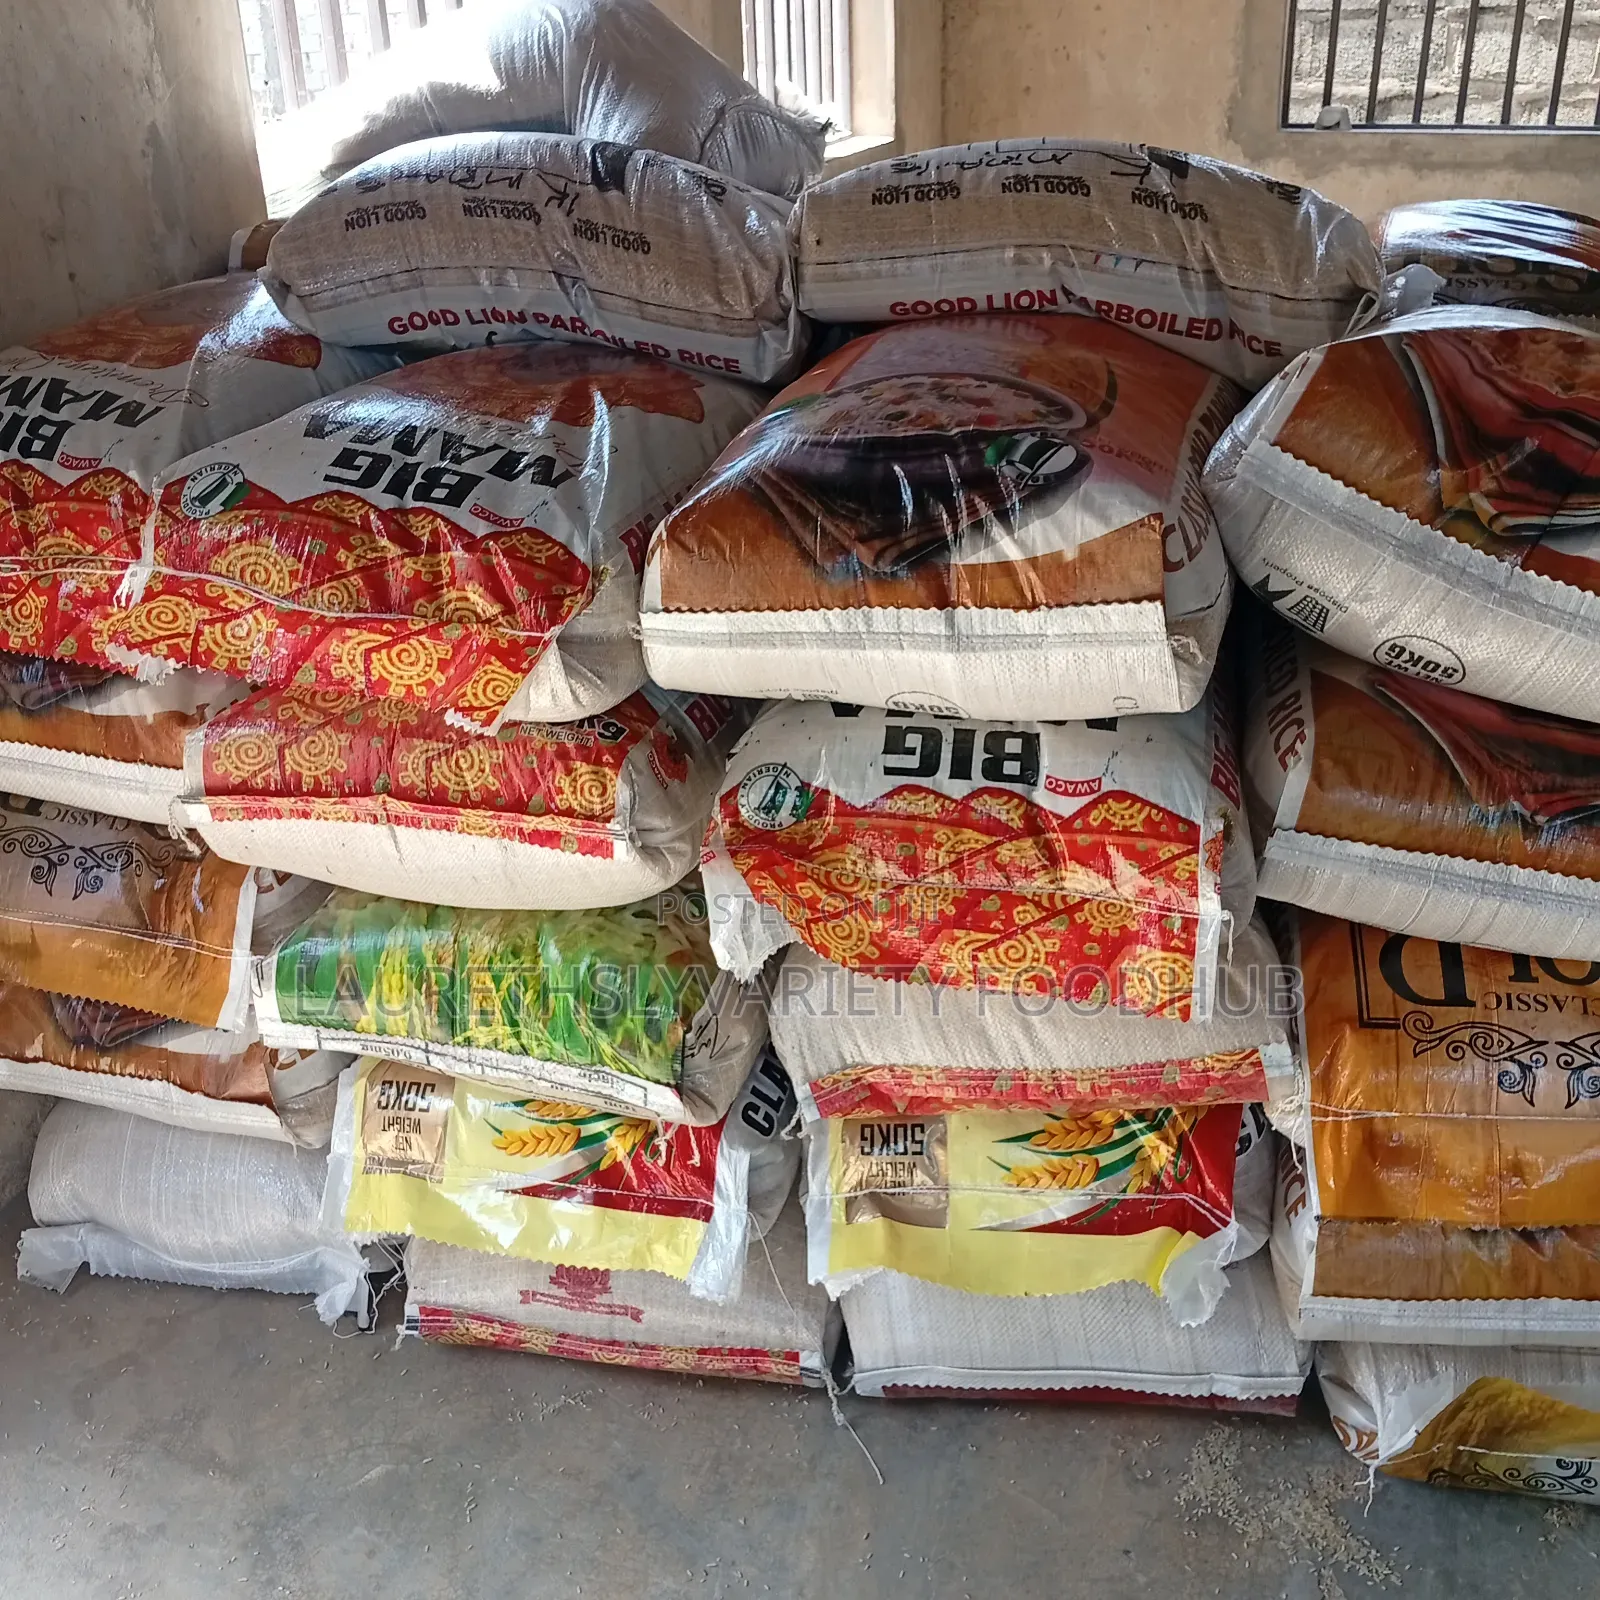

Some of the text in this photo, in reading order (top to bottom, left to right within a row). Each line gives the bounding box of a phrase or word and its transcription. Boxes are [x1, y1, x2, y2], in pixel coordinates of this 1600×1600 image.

[871, 186, 961, 206] GOOD LION
[1001, 180, 1091, 197] GOOD LION
[344, 206, 427, 232] GOOD LION
[462, 203, 542, 226] GOOD LION
[573, 223, 651, 254] GOOD LION
[889, 296, 978, 316] GOOD
[986, 288, 1058, 312] LION
[389, 306, 742, 374] GOOD LION PAROILED RICE
[0, 411, 76, 461] BI
[58, 453, 102, 469] AWACO
[190, 464, 240, 483] NGERIAN
[323, 447, 486, 508] BIG
[470, 504, 522, 527] AWACO
[1385, 642, 1459, 679] 50KG
[519, 724, 544, 737] NET
[1267, 689, 1307, 773] RICE
[882, 725, 1040, 786] BIG
[742, 765, 791, 790] NGERIAN
[1045, 778, 1099, 798] AWACO
[45, 807, 130, 832] CLASSIC
[739, 803, 784, 829] PROUDLY
[377, 1079, 436, 1113] 50KG
[741, 1058, 792, 1138] CLA
[381, 1116, 422, 1134] WEIGHT
[860, 1123, 925, 1156] 50KG
[869, 1161, 917, 1179] WEIGHT
